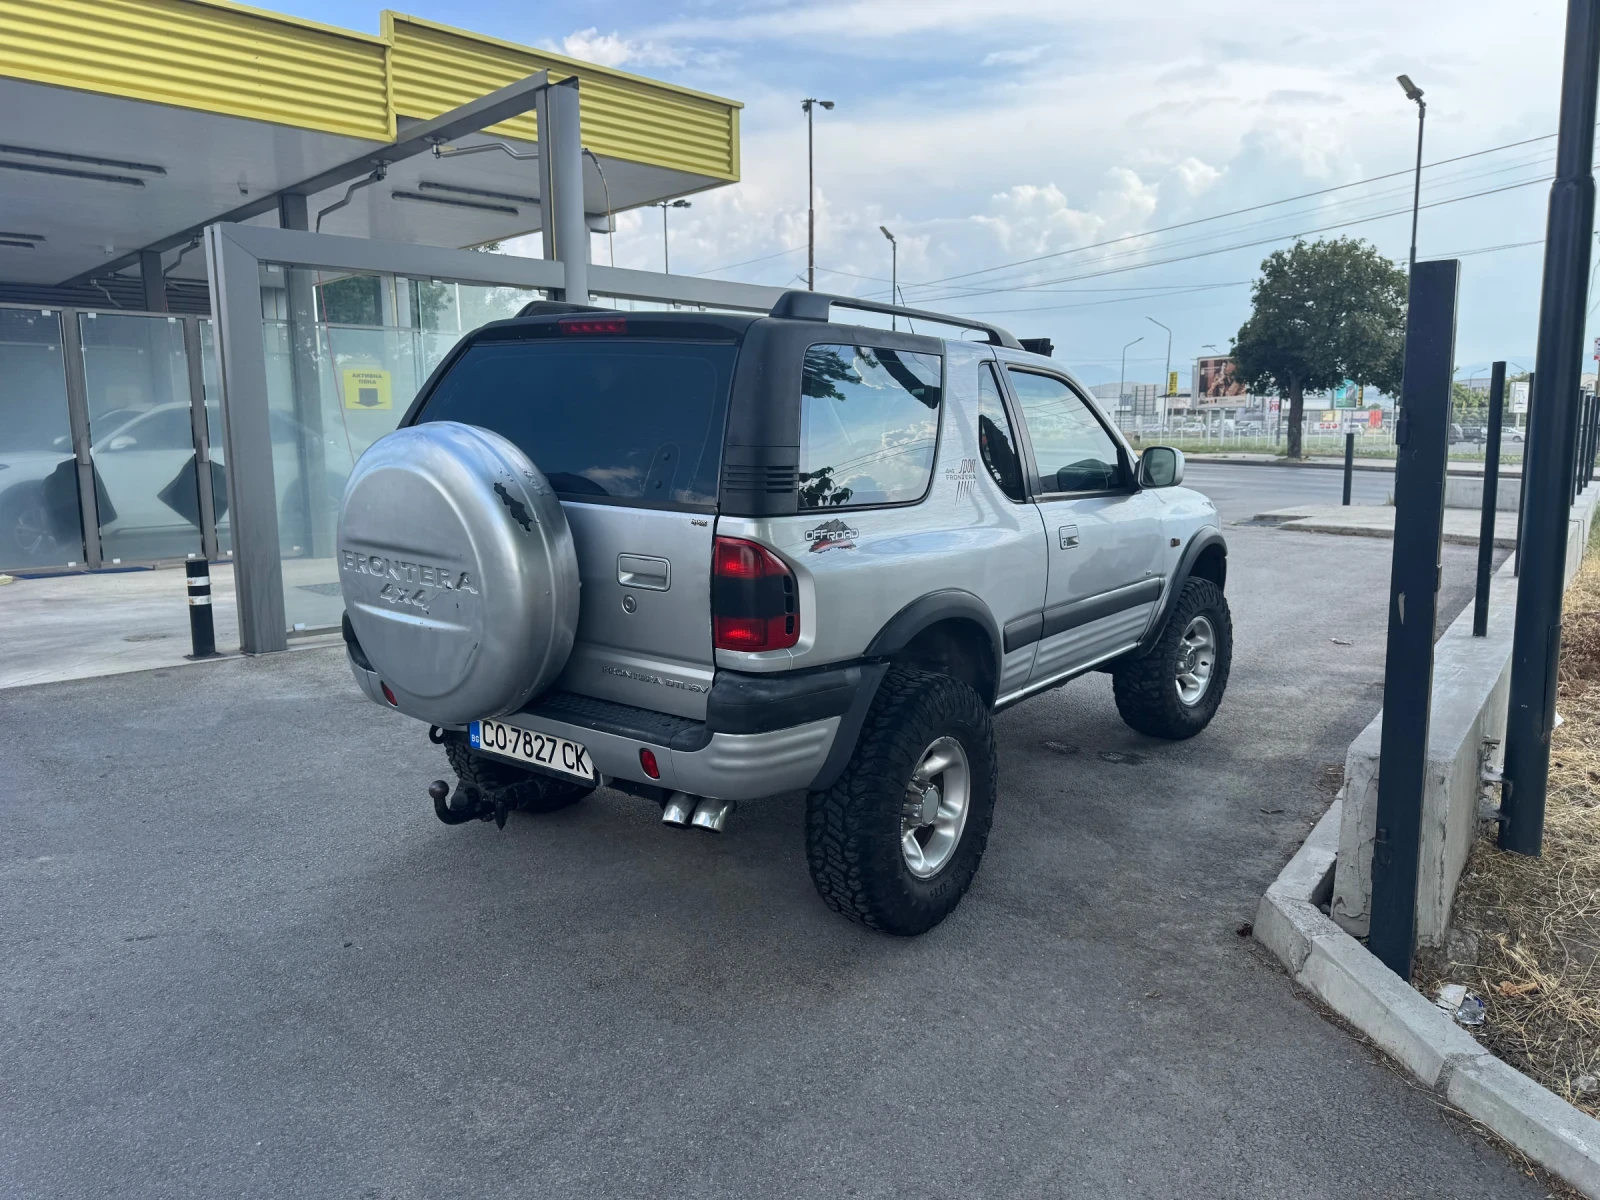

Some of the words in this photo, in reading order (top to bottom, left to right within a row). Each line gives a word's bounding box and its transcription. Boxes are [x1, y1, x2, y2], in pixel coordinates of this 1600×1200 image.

[805, 528, 860, 541] OFFROAD
[341, 549, 479, 594] FRONTERA
[602, 666, 664, 685] FRONTERA
[471, 734, 480, 743] BG
